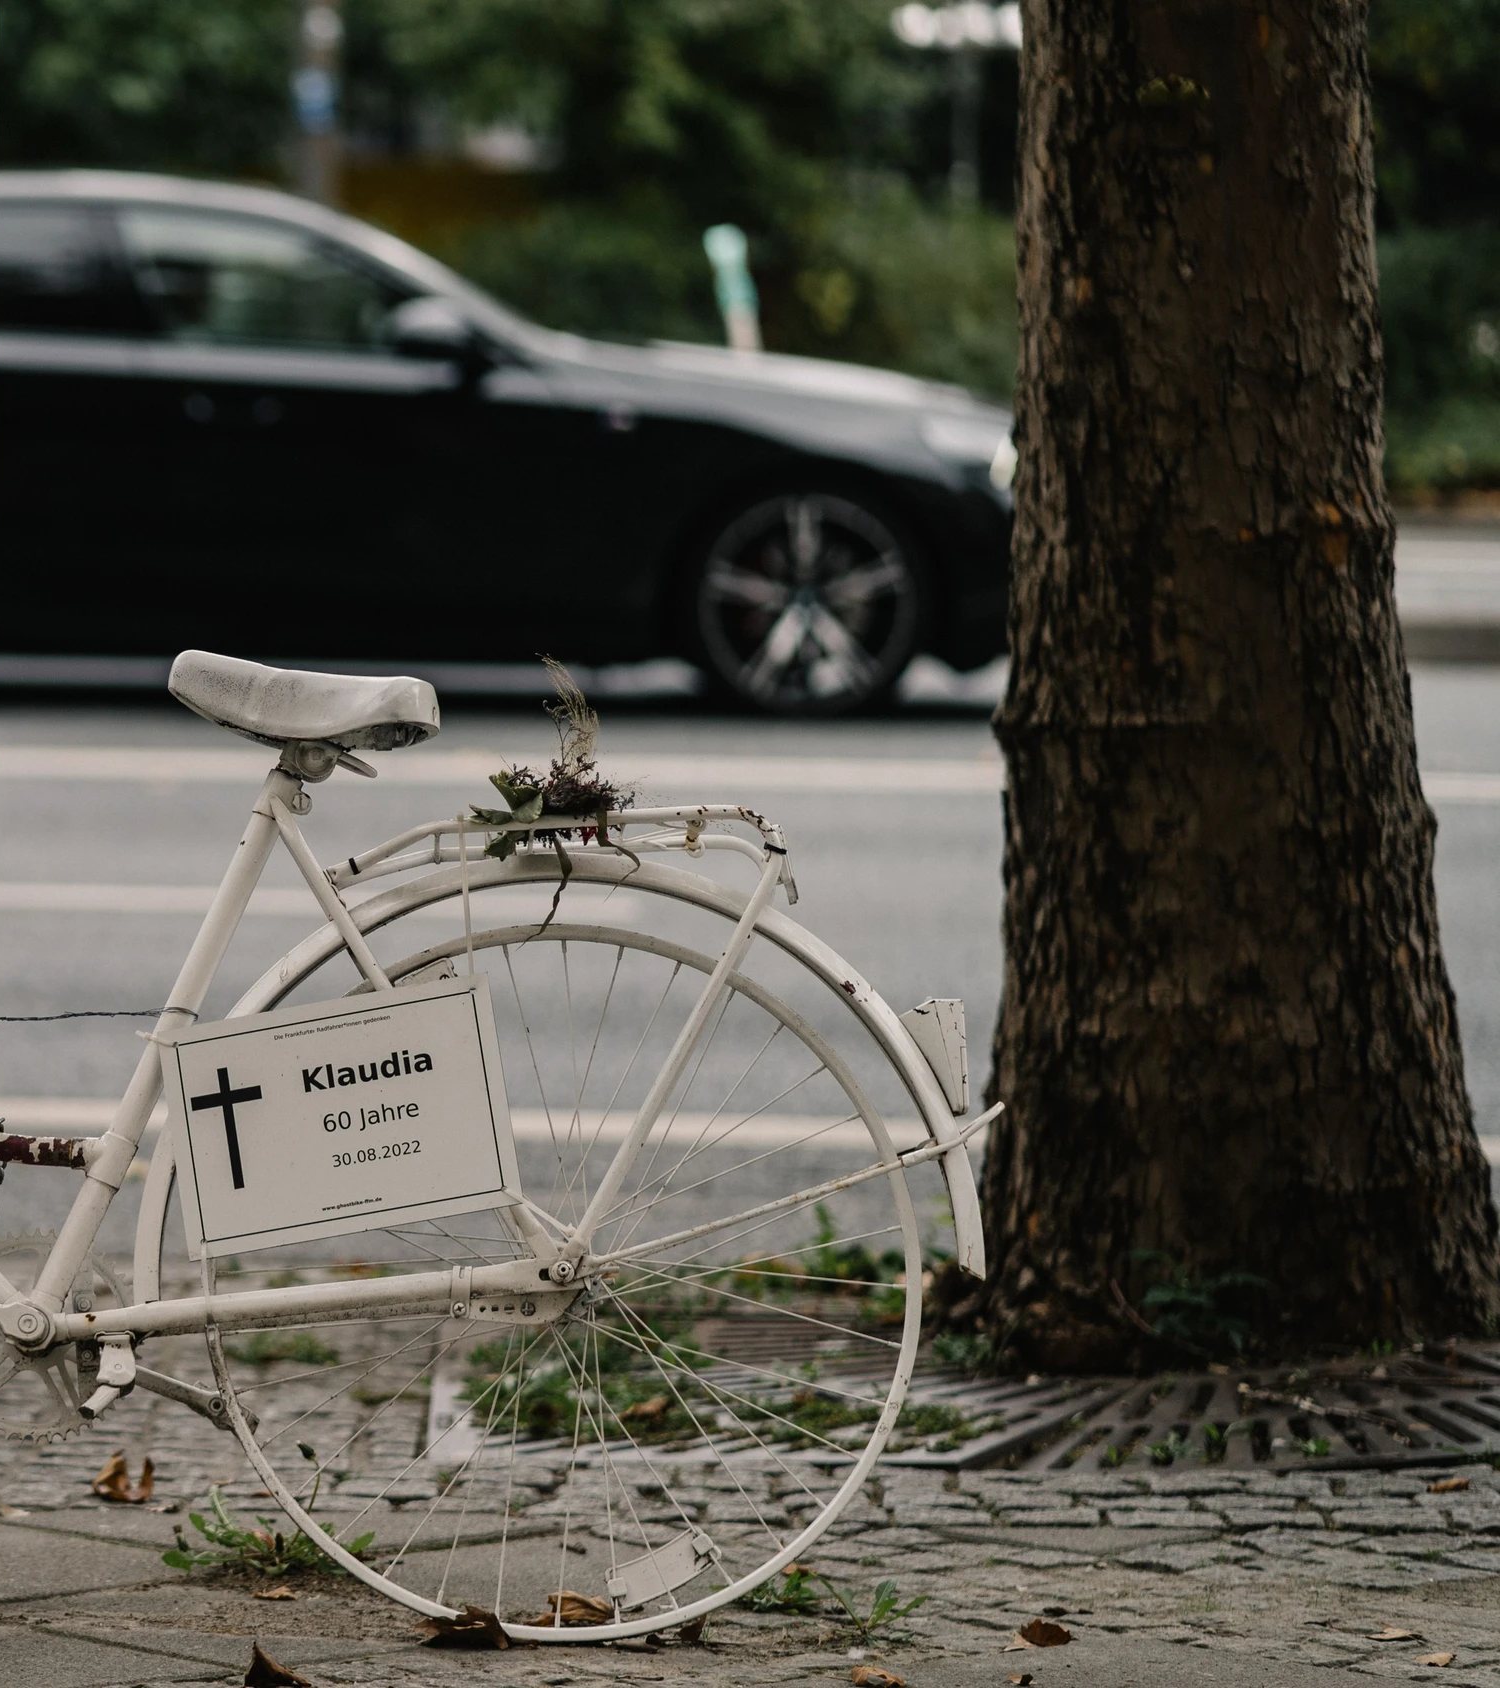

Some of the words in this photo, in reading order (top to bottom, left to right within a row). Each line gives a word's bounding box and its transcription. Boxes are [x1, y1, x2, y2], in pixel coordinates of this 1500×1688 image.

[362, 1015, 391, 1026] gedenken
[301, 1049, 433, 1093] Klaudia
[323, 1110, 352, 1133] 60
[359, 1102, 420, 1132] Jahre
[332, 1140, 422, 1168] 30.08.2022
[322, 1196, 382, 1212] www.ghostbike-ffm.de
